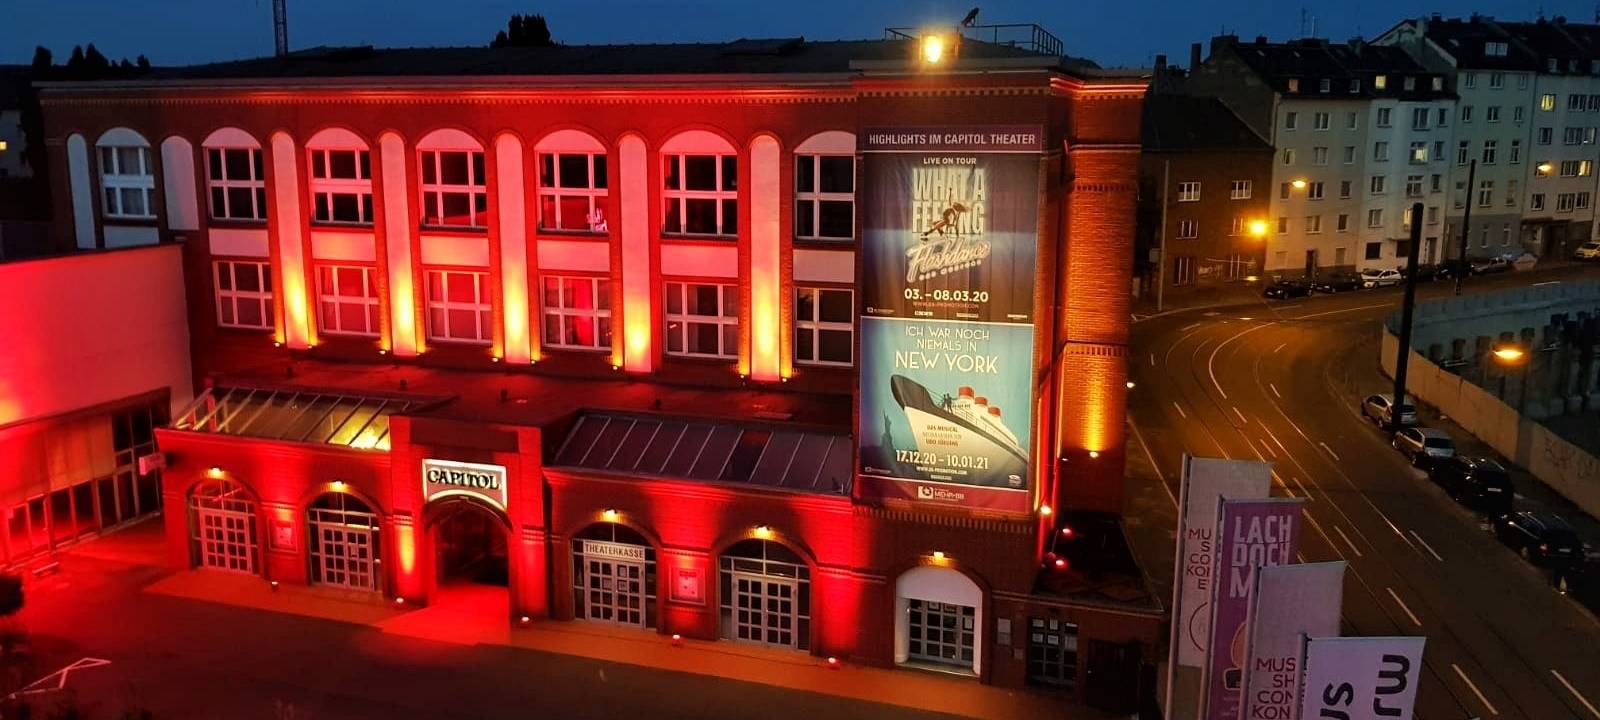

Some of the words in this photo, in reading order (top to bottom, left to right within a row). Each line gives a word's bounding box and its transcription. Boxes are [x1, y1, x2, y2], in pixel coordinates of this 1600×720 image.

[869, 133, 926, 145] HIGHLIGHTS
[929, 134, 941, 145] IM
[944, 134, 986, 145] CAPITOL
[990, 134, 1036, 145] THEATER
[923, 157, 940, 165] LIVE
[942, 157, 954, 165] ON
[956, 157, 977, 165] TOUR
[912, 167, 971, 201] WHAT
[972, 167, 986, 201] A
[905, 237, 992, 283] Flashdance
[904, 288, 923, 300] 03.
[933, 289, 989, 303] 08.03.20
[905, 325, 924, 337] ICH
[929, 327, 951, 338] WAR
[955, 328, 990, 341] NOCH
[917, 338, 962, 351] NIEMALS
[966, 340, 977, 352] IN
[895, 351, 940, 369] NEW
[945, 354, 1000, 374] YORK
[896, 449, 937, 465] 17.12.20
[947, 454, 988, 470] 10.01.21
[427, 468, 500, 490] CAPITOL
[1232, 515, 1293, 544] LACH
[584, 542, 645, 559] THEATERKASSE
[1231, 543, 1291, 568] DOCH
[1255, 657, 1297, 672] MUS
